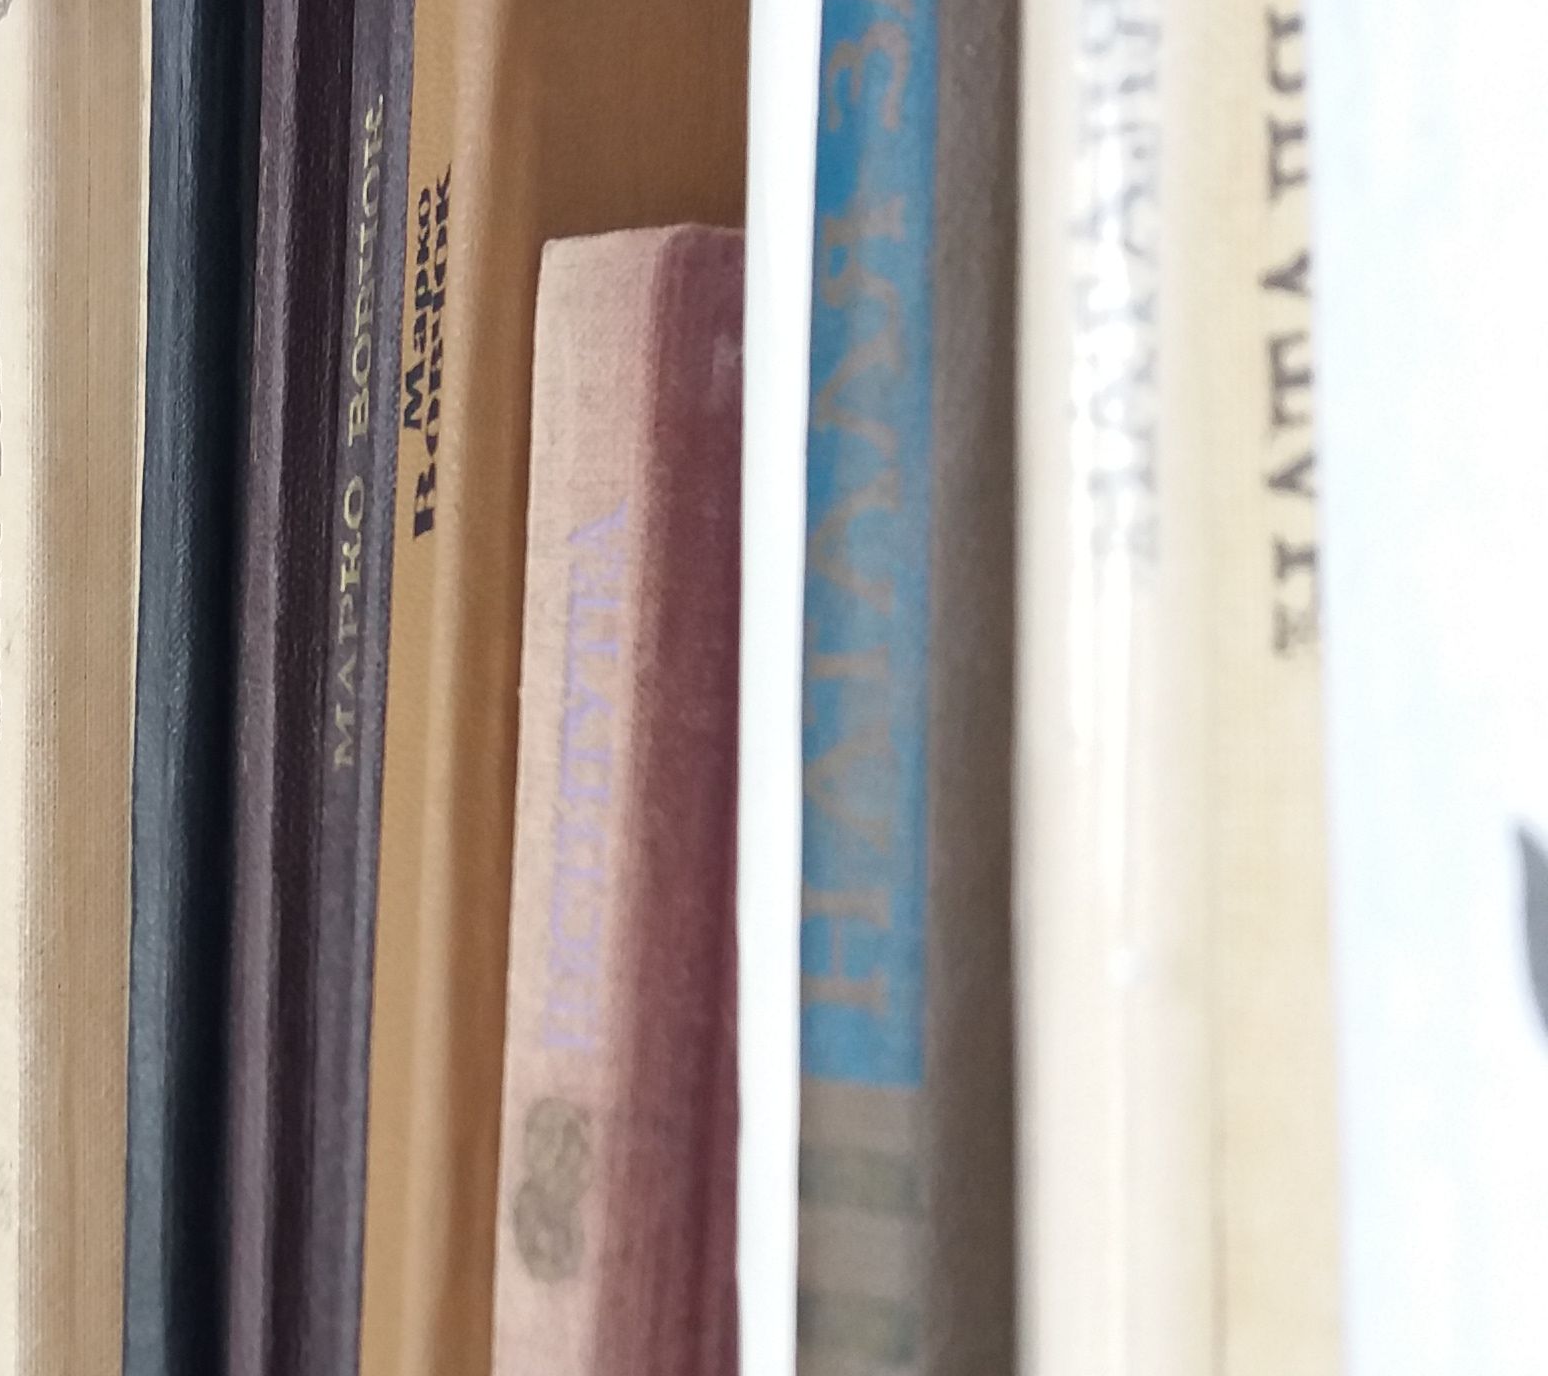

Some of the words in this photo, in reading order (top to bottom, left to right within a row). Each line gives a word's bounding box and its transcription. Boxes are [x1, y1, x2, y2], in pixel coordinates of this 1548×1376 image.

[401, 187, 433, 431] Марко
[332, 476, 369, 769] МАРКО
[806, 198, 908, 1016] НАТАЛЯ
